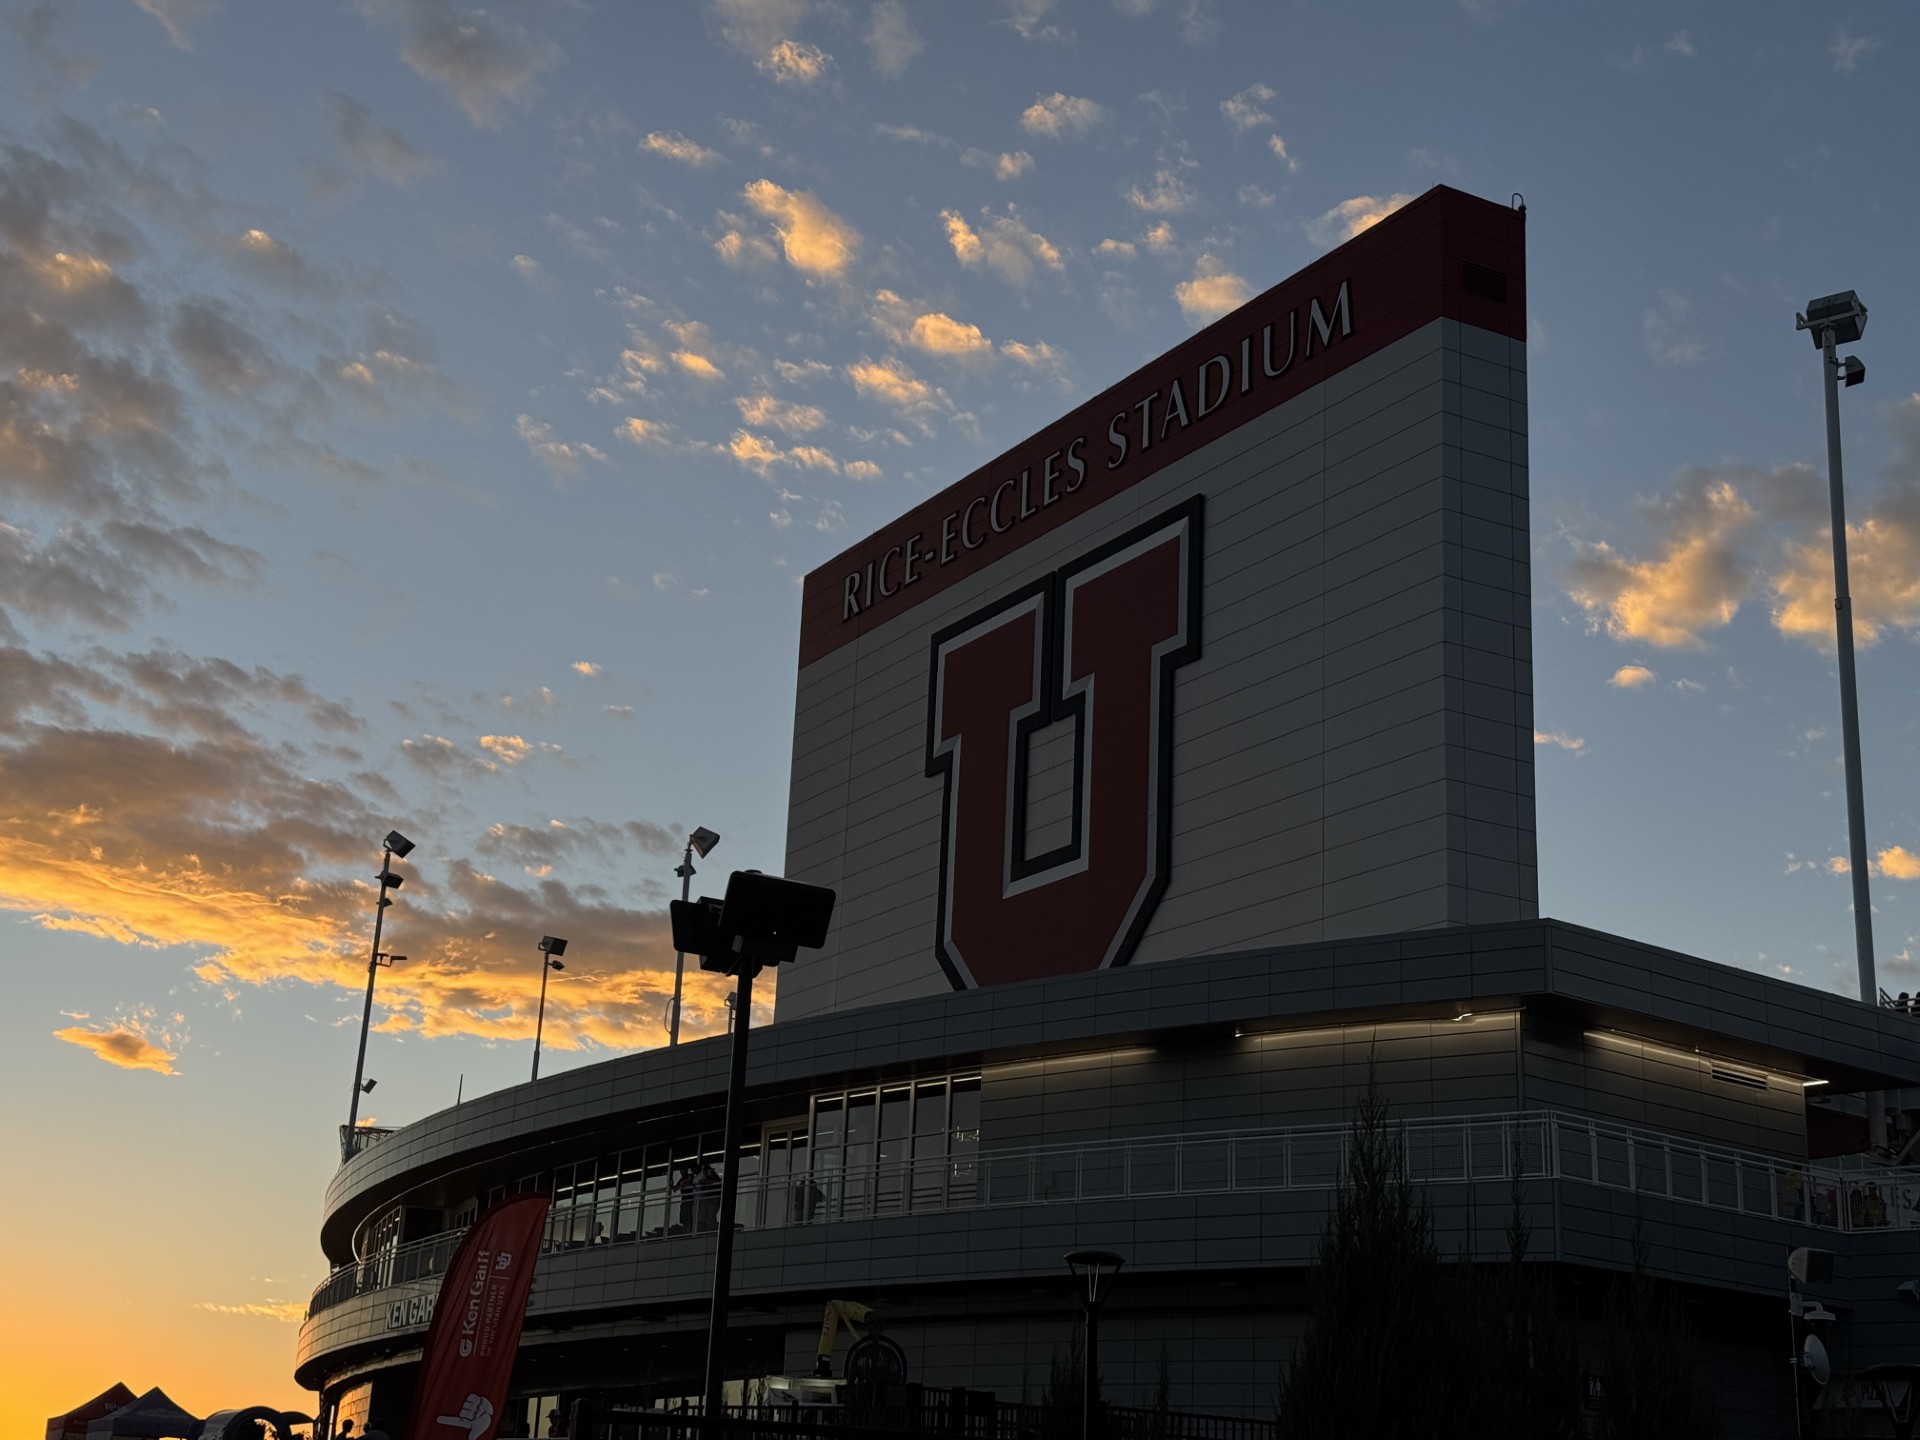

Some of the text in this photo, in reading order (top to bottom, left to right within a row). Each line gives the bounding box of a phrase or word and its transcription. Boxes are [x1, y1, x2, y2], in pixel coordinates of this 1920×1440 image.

[843, 277, 1355, 623] RICE-ECCLES STADIUM
[470, 1250, 490, 1296] Garff
[387, 1292, 440, 1329] KEN GAR
[462, 1299, 480, 1336] Ken
[480, 1284, 498, 1357] PROUD PARTNER
